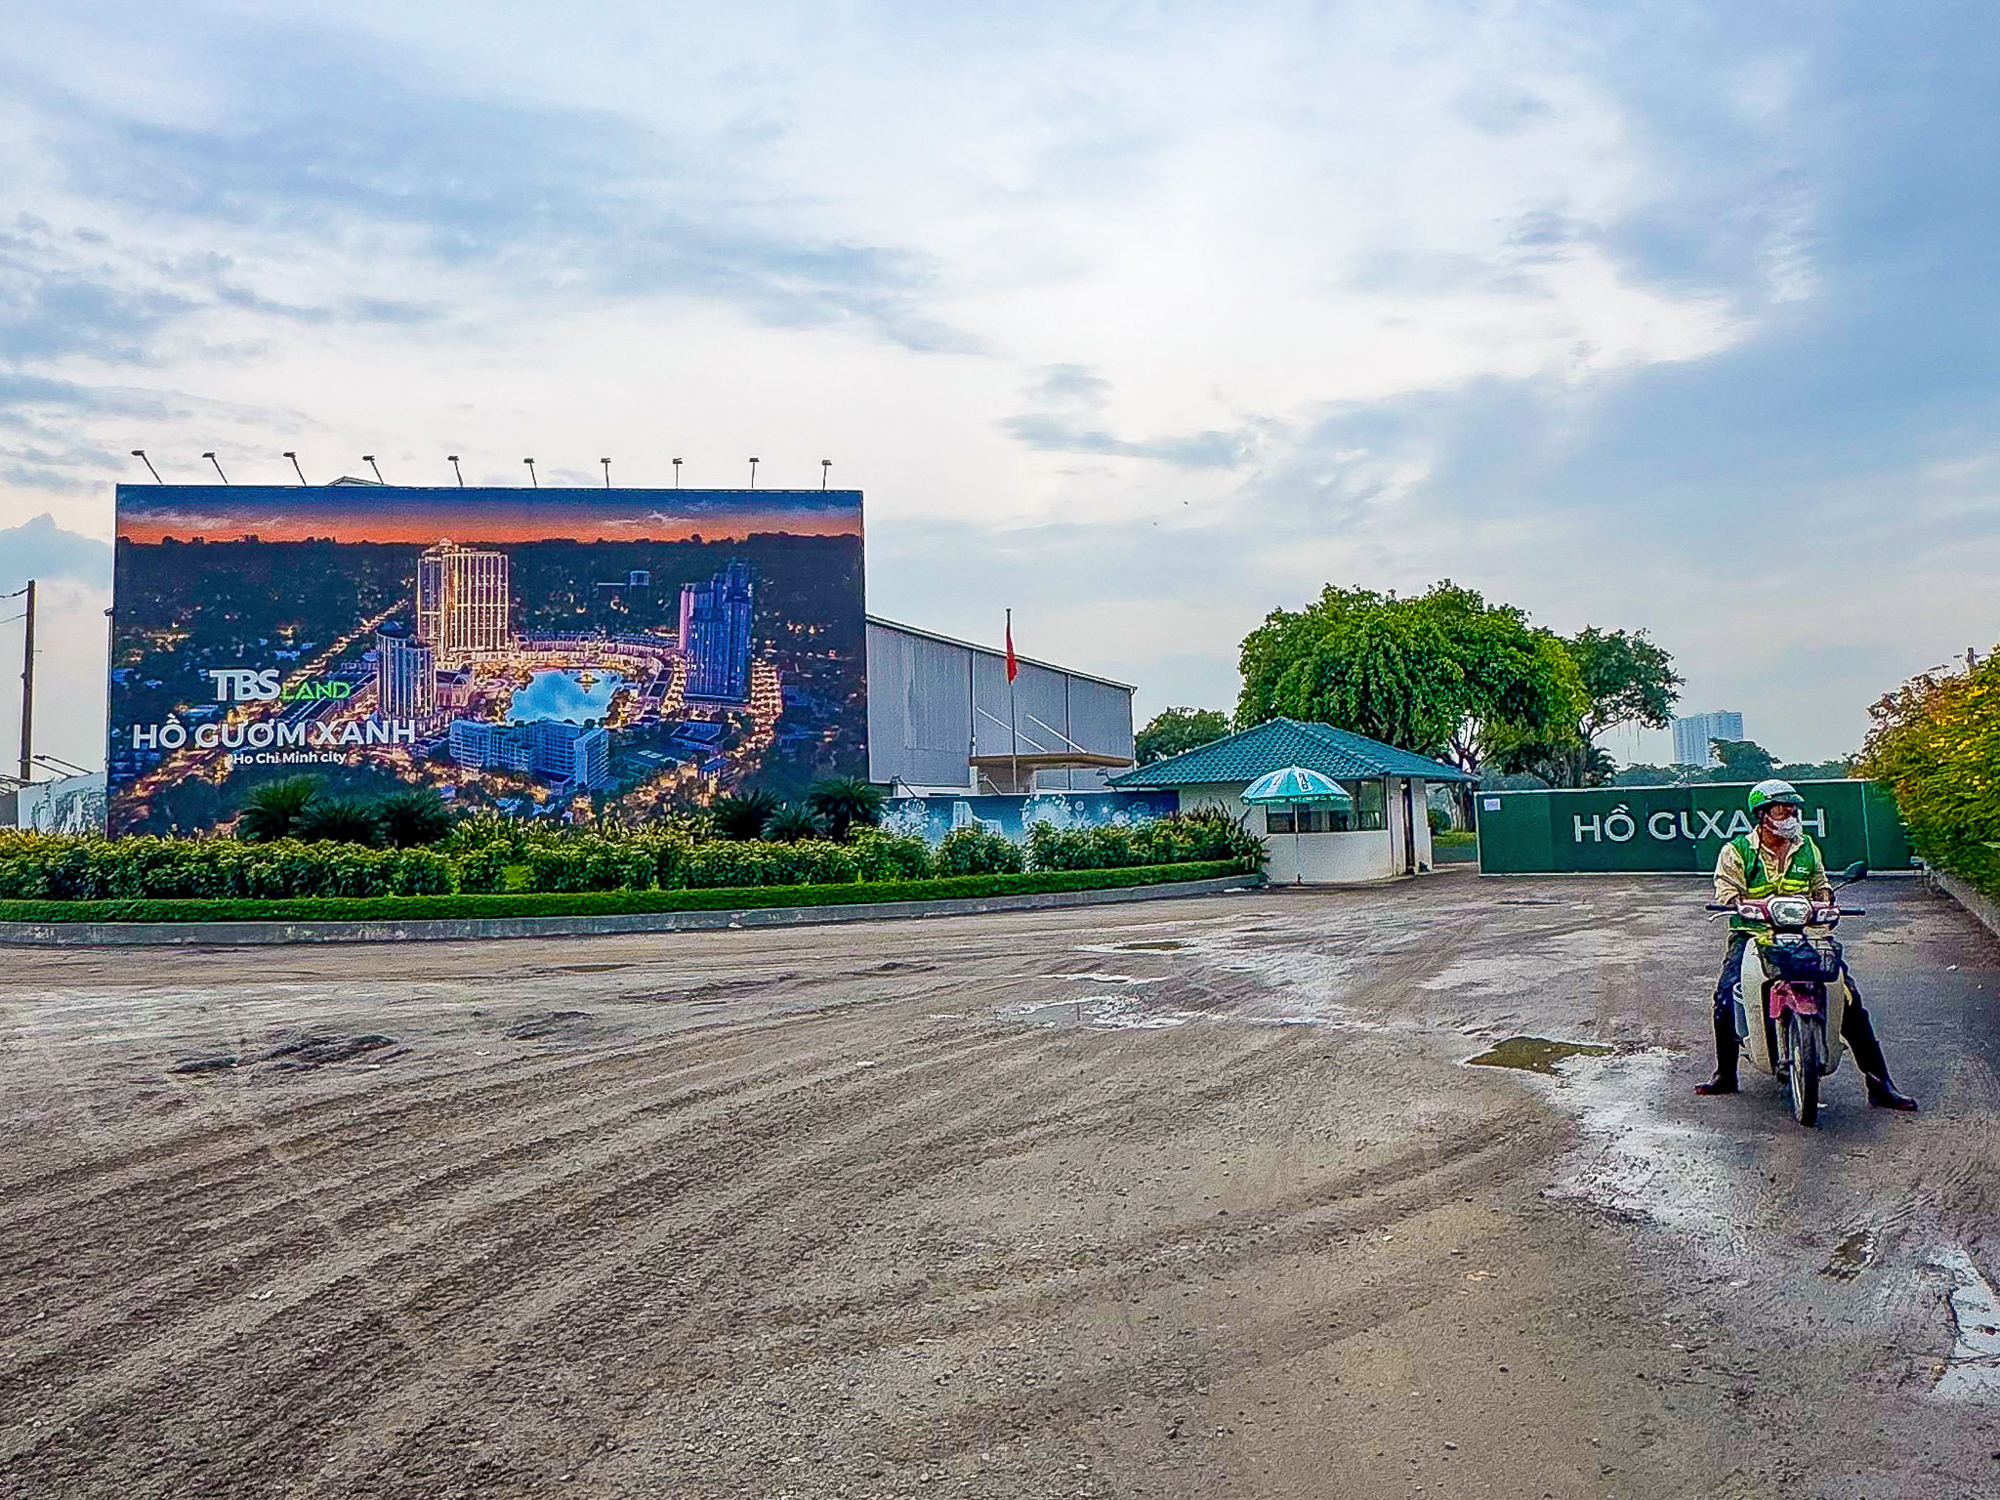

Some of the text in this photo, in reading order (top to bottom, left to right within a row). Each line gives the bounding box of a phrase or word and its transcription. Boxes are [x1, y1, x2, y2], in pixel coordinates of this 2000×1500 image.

[209, 669, 351, 701] TBS LAND
[132, 712, 416, 749] HỒ GƯƠM XANH
[233, 750, 346, 765] Ho Chi Minh city
[1573, 803, 1635, 843] HỒ
[1696, 808, 1826, 840] XAH
